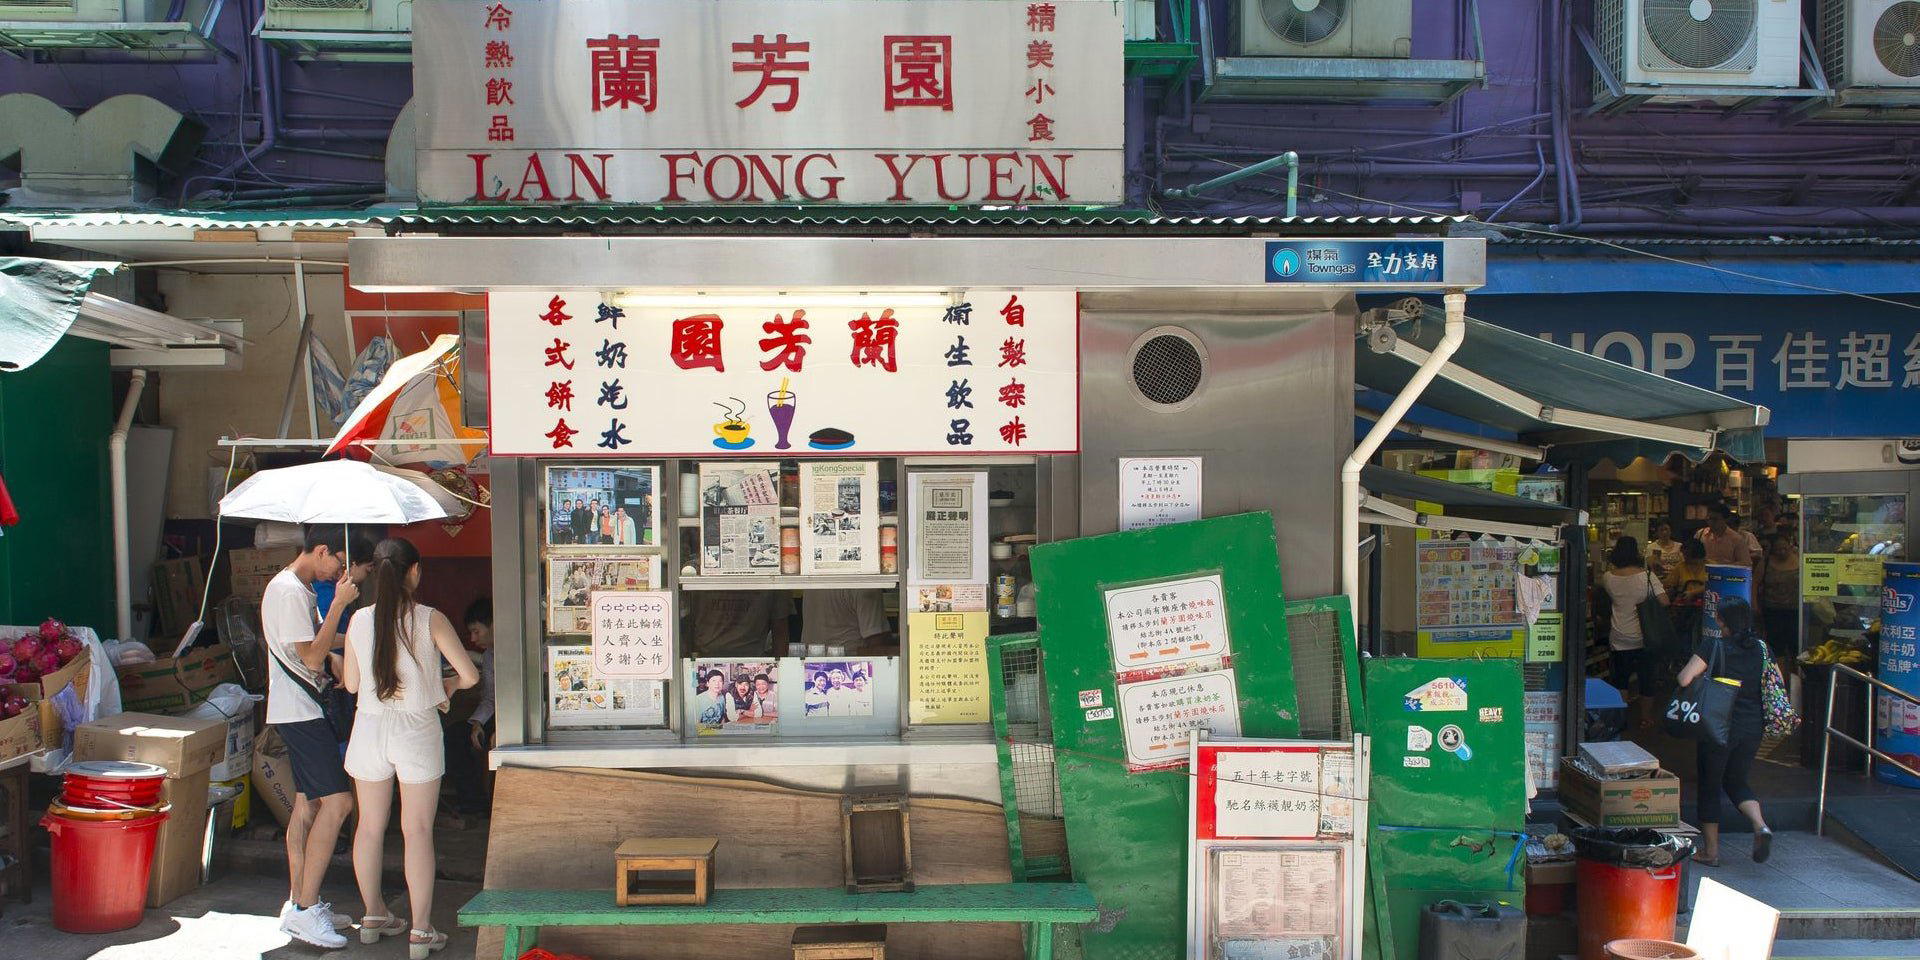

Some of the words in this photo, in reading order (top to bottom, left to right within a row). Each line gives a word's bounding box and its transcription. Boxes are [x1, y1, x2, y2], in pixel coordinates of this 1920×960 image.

[484, 2, 514, 142] 冷熱飲品
[587, 34, 954, 112] 蘭芳園
[1025, 2, 1056, 142] 精美小食
[467, 152, 614, 201] LAN
[660, 150, 845, 201] FONG
[874, 152, 1074, 201] YUEN
[1306, 249, 1339, 261] 煤氣
[1307, 262, 1355, 275] Towngas
[1367, 252, 1438, 275] 全力支持
[538, 294, 580, 451] 各式餅食
[926, 510, 969, 521] 嚴正聲明
[601, 618, 663, 630] 請在此輪候
[603, 634, 663, 647] 人齊入坐
[604, 652, 663, 666] 多謝合作
[1666, 699, 1700, 724] 2%
[261, 761, 275, 779] TS
[1233, 769, 1313, 783] 五十年老字號
[1225, 799, 1320, 812] 馳名絲襪靚奶茶
